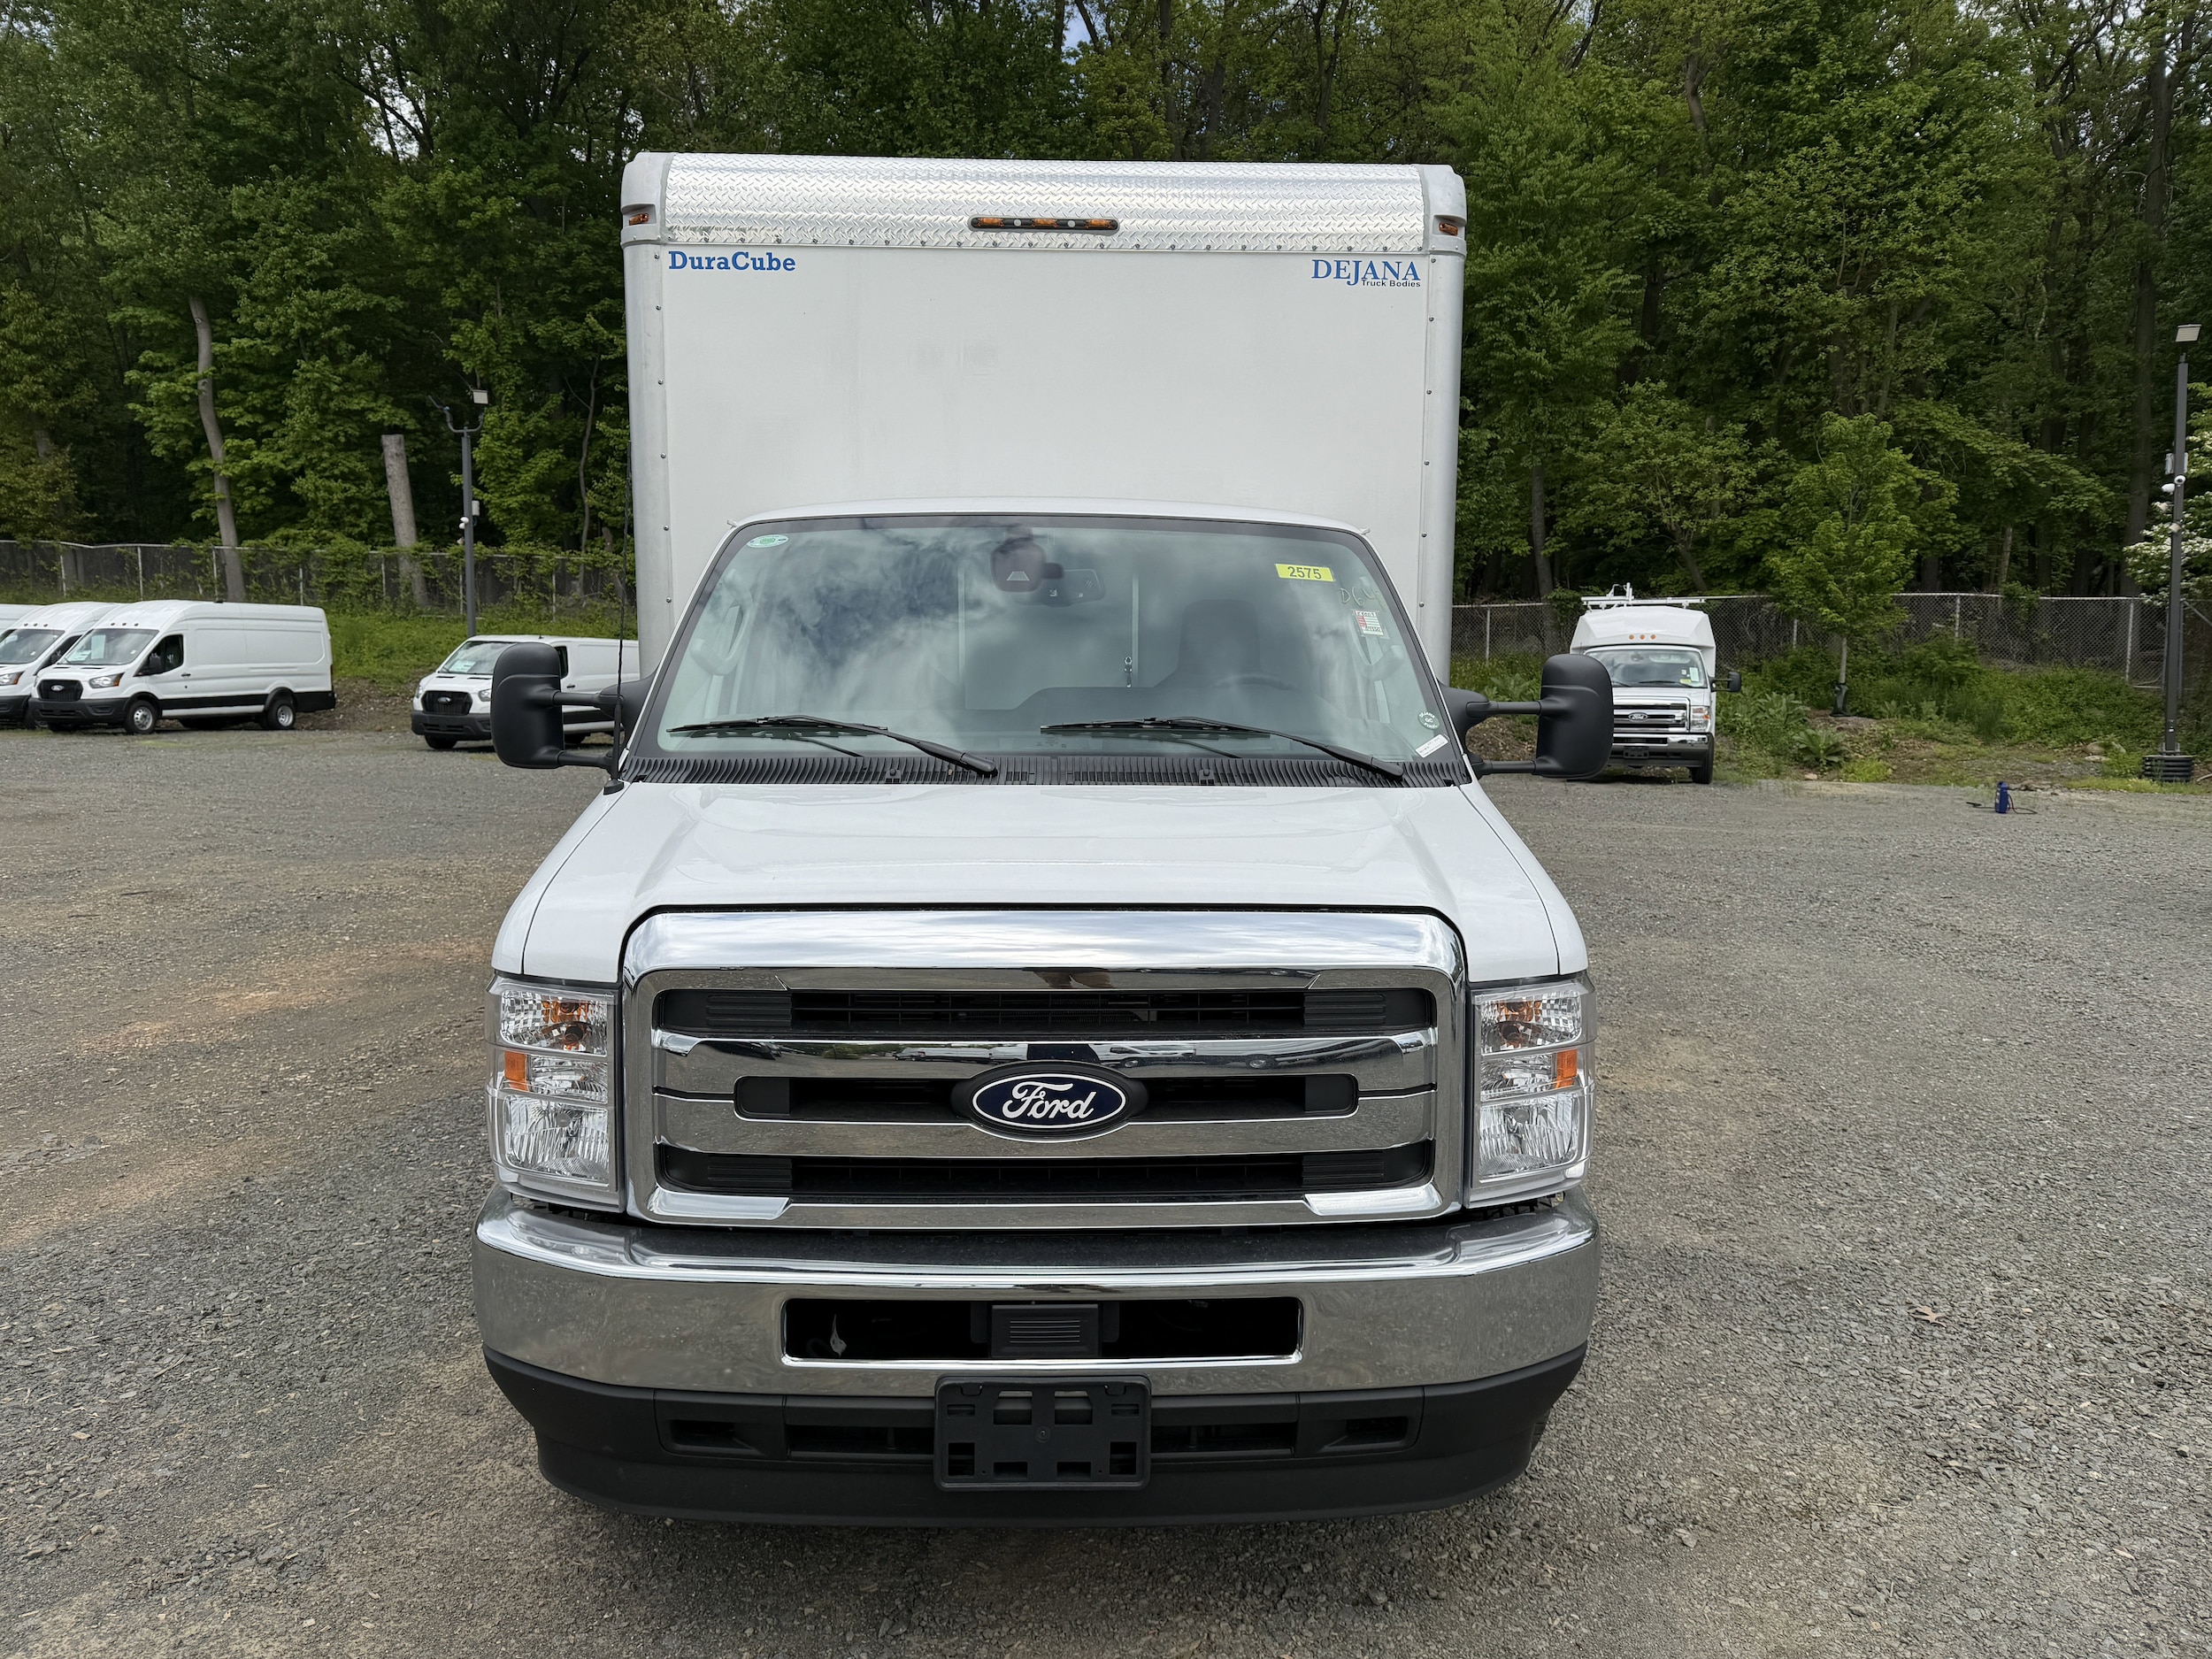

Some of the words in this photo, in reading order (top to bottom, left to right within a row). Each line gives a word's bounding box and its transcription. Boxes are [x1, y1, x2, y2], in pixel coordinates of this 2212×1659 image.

[668, 250, 796, 272] DuraCube
[1311, 258, 1421, 287] DEJANA
[1361, 279, 1386, 288] Truck
[1287, 566, 1322, 580] 2575
[1002, 1080, 1097, 1119] Ford
